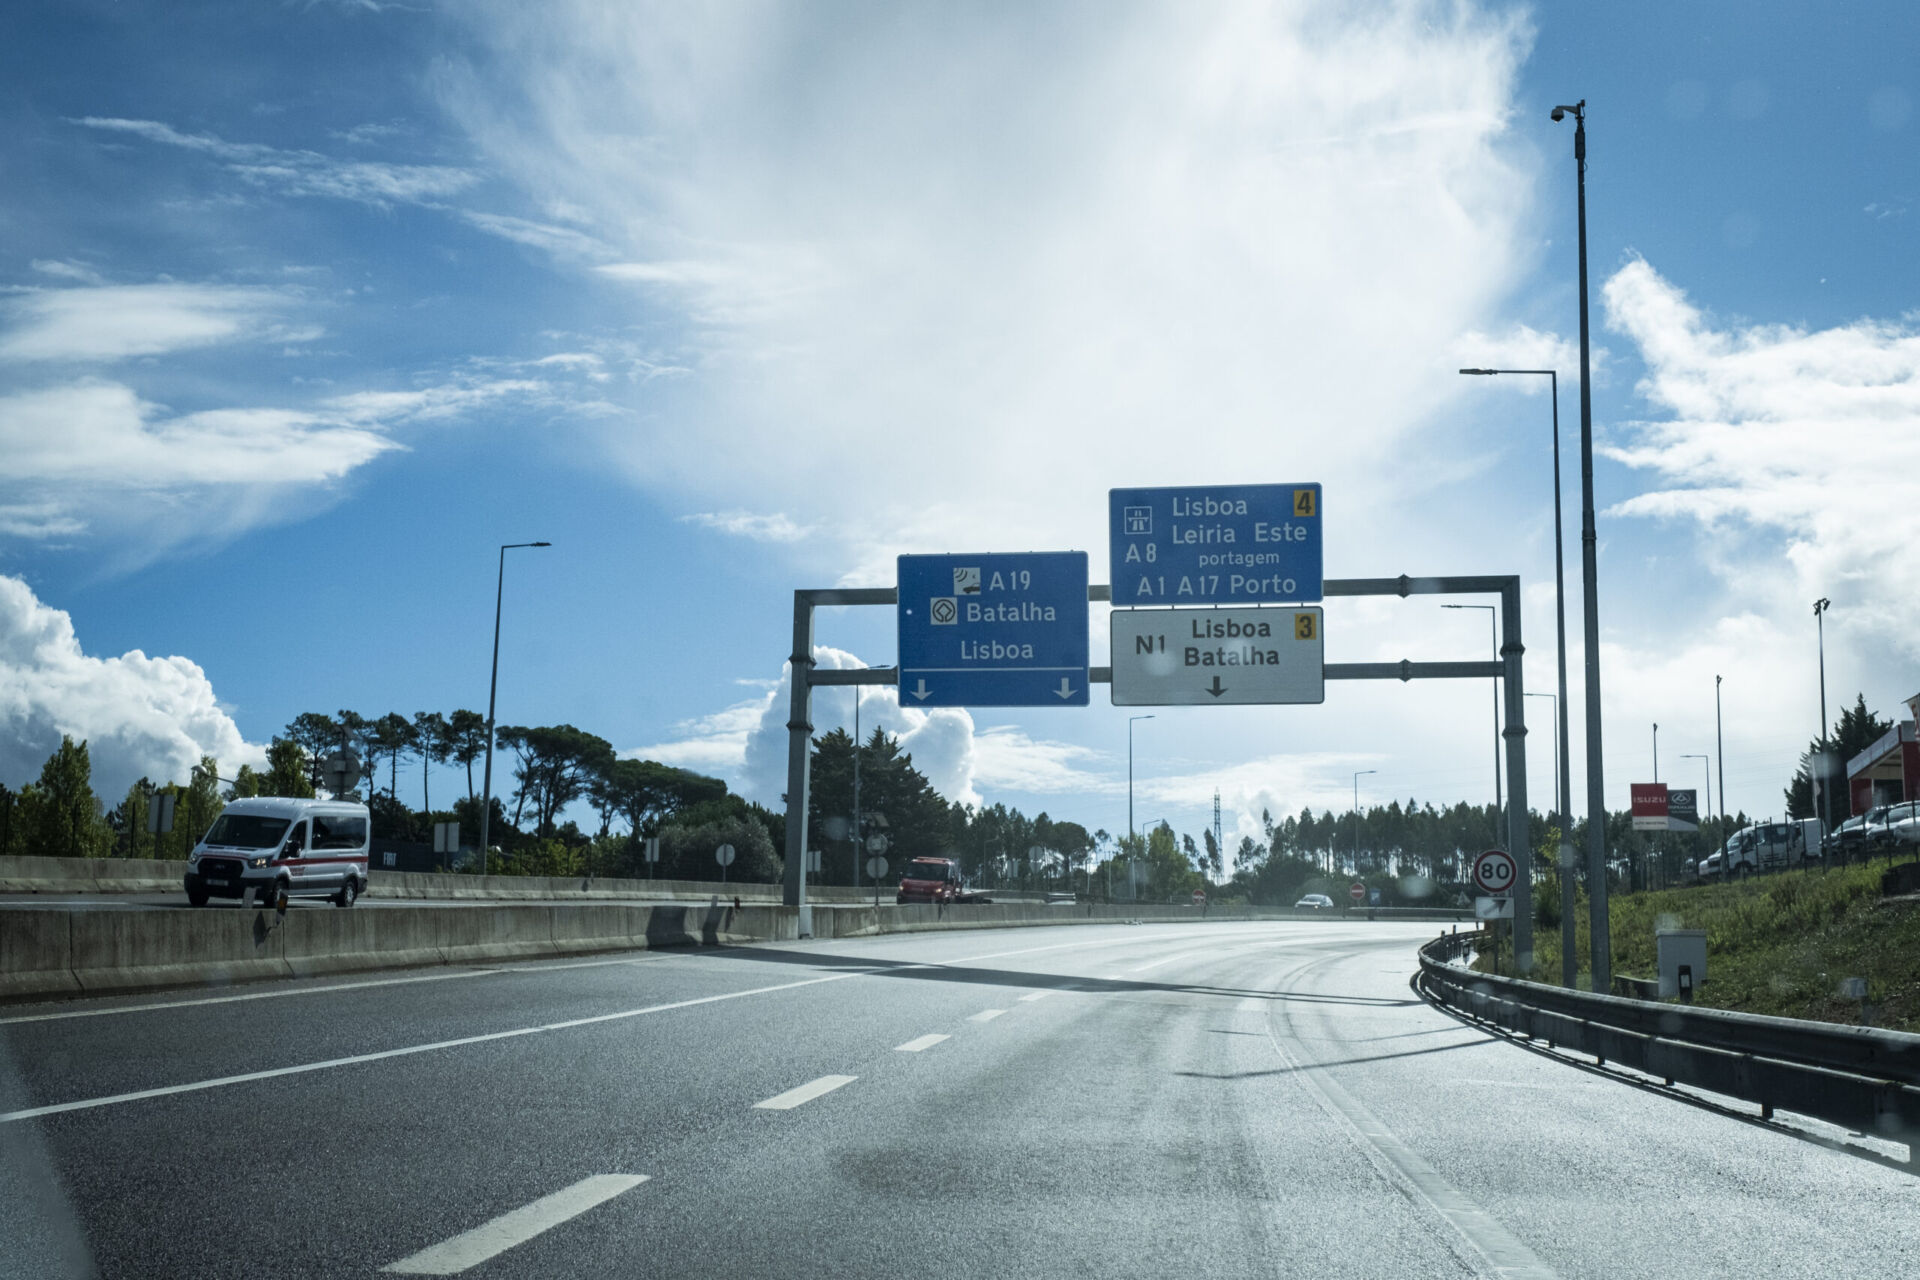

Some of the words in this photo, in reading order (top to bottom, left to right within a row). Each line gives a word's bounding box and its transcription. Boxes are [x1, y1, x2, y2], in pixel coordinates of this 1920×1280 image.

[1173, 496, 1248, 517] Lisboa
[1297, 491, 1312, 514] 4
[1172, 524, 1236, 545] Leiria
[1255, 522, 1308, 542] Este
[1199, 551, 1280, 568] portagem
[989, 570, 1031, 591] A19
[1137, 576, 1165, 596] A1
[1177, 575, 1219, 596] A17
[1230, 574, 1296, 595] Porto
[967, 602, 1056, 622] Batalha
[1192, 618, 1271, 639] Lisboa
[1299, 615, 1312, 639] 3
[961, 640, 1034, 660] Lisboa
[1136, 634, 1165, 655] N1
[1184, 646, 1280, 667] Batalha
[1633, 796, 1666, 804] ISUZU
[383, 852, 397, 866] FIAT
[1480, 862, 1510, 880] 80
